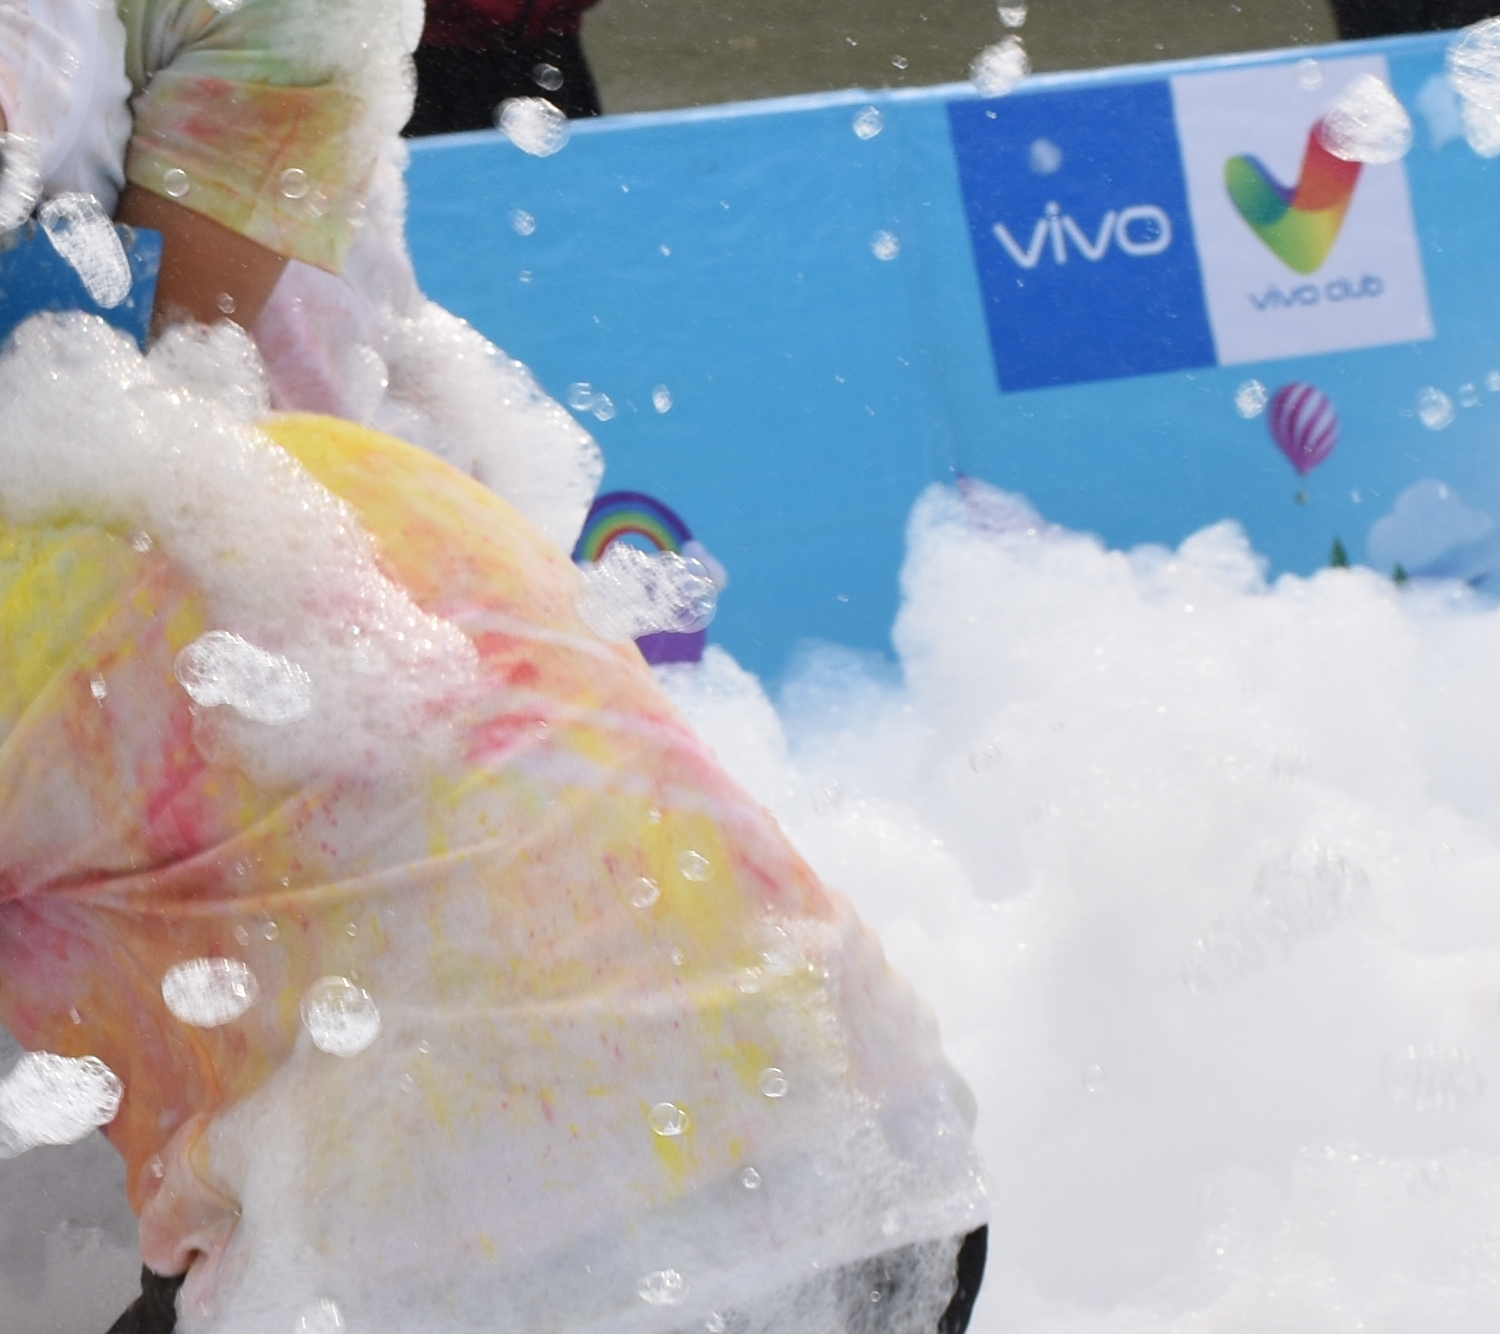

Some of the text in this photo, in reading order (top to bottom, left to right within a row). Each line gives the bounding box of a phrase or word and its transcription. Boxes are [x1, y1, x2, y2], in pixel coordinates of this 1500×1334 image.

[993, 201, 1172, 268] vivo
[1249, 274, 1385, 310] vivo club
